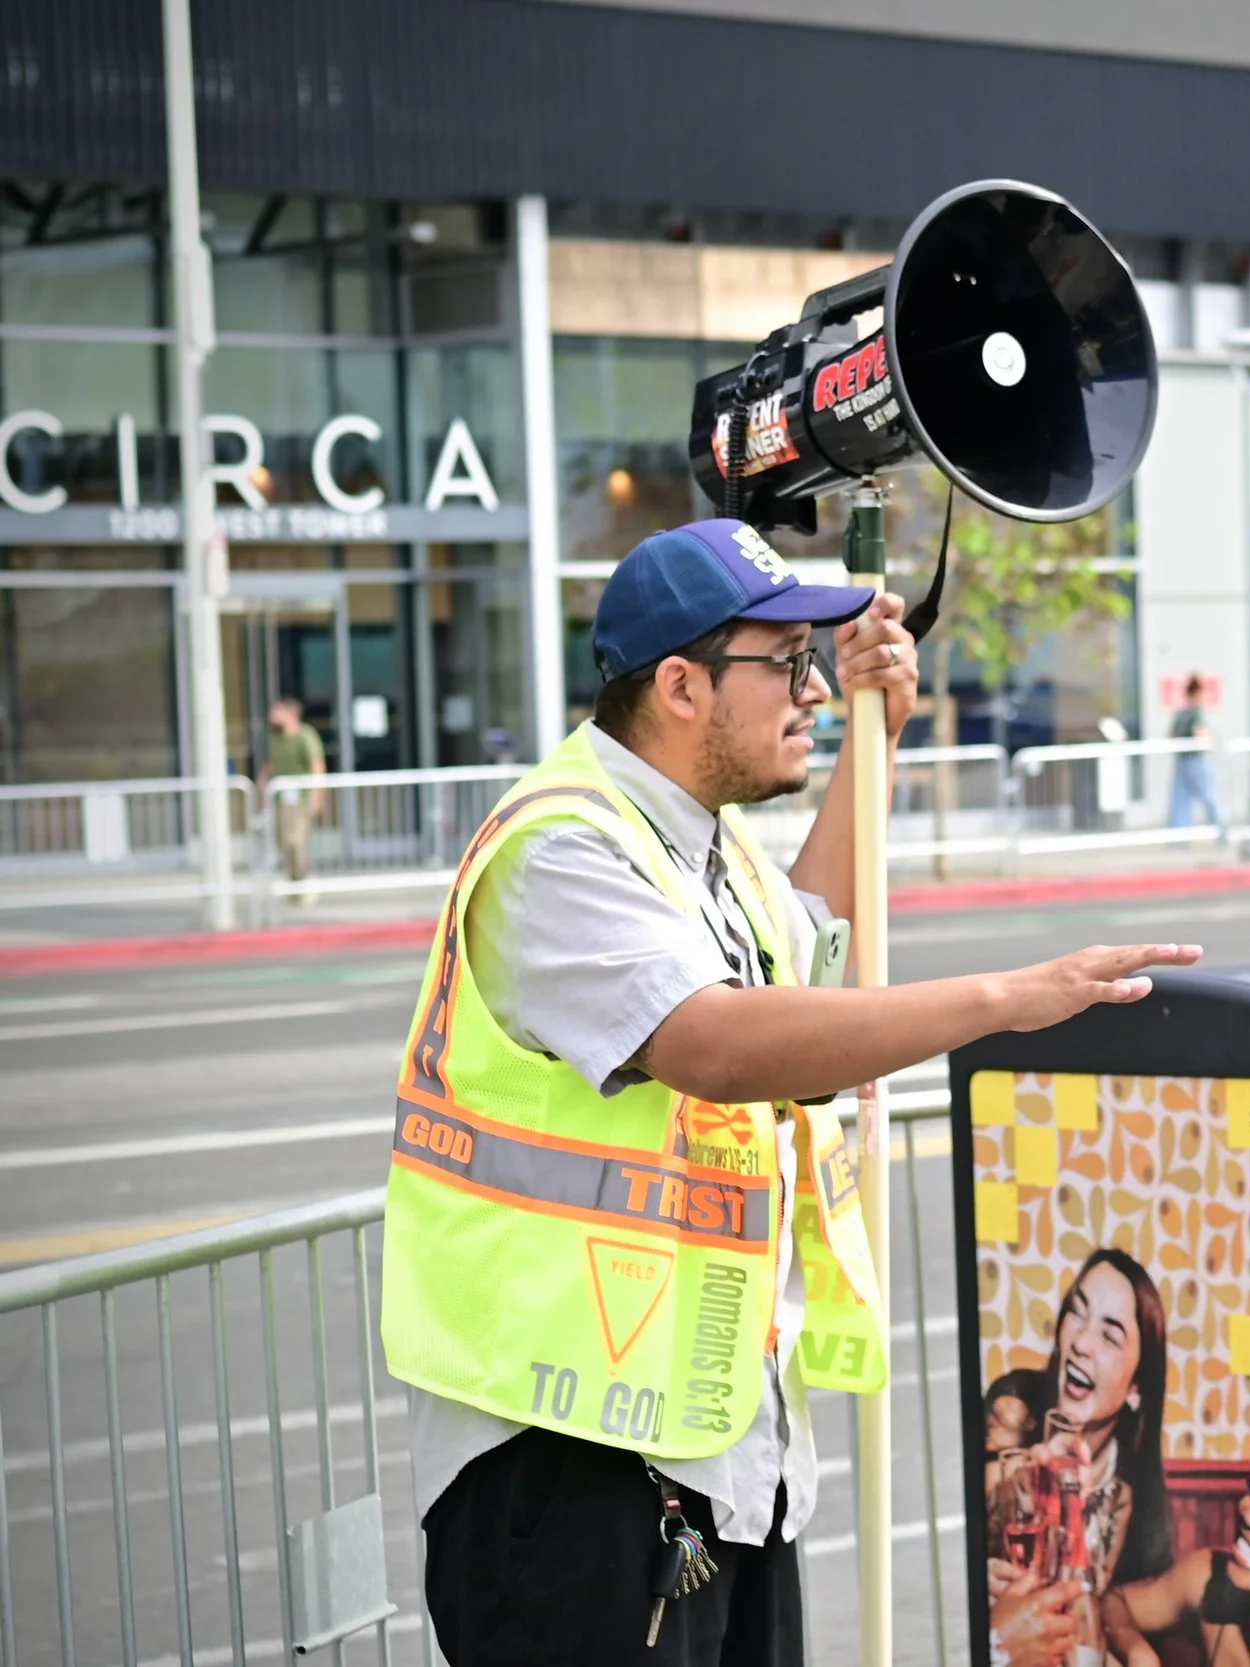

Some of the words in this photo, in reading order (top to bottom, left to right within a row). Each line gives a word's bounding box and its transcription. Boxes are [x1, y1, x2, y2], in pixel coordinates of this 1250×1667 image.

[813, 335, 889, 412] REPE
[716, 389, 784, 446] RENT
[0, 409, 498, 513] CIRCA
[289, 508, 388, 539] TOWER
[401, 1112, 474, 1165] GOD
[689, 1139, 728, 1168] ebrews
[621, 1167, 745, 1234] TRST
[611, 1258, 656, 1281] YIELD
[689, 1262, 748, 1375] Romans
[530, 1361, 578, 1420] TO
[681, 1377, 734, 1434] 6:13
